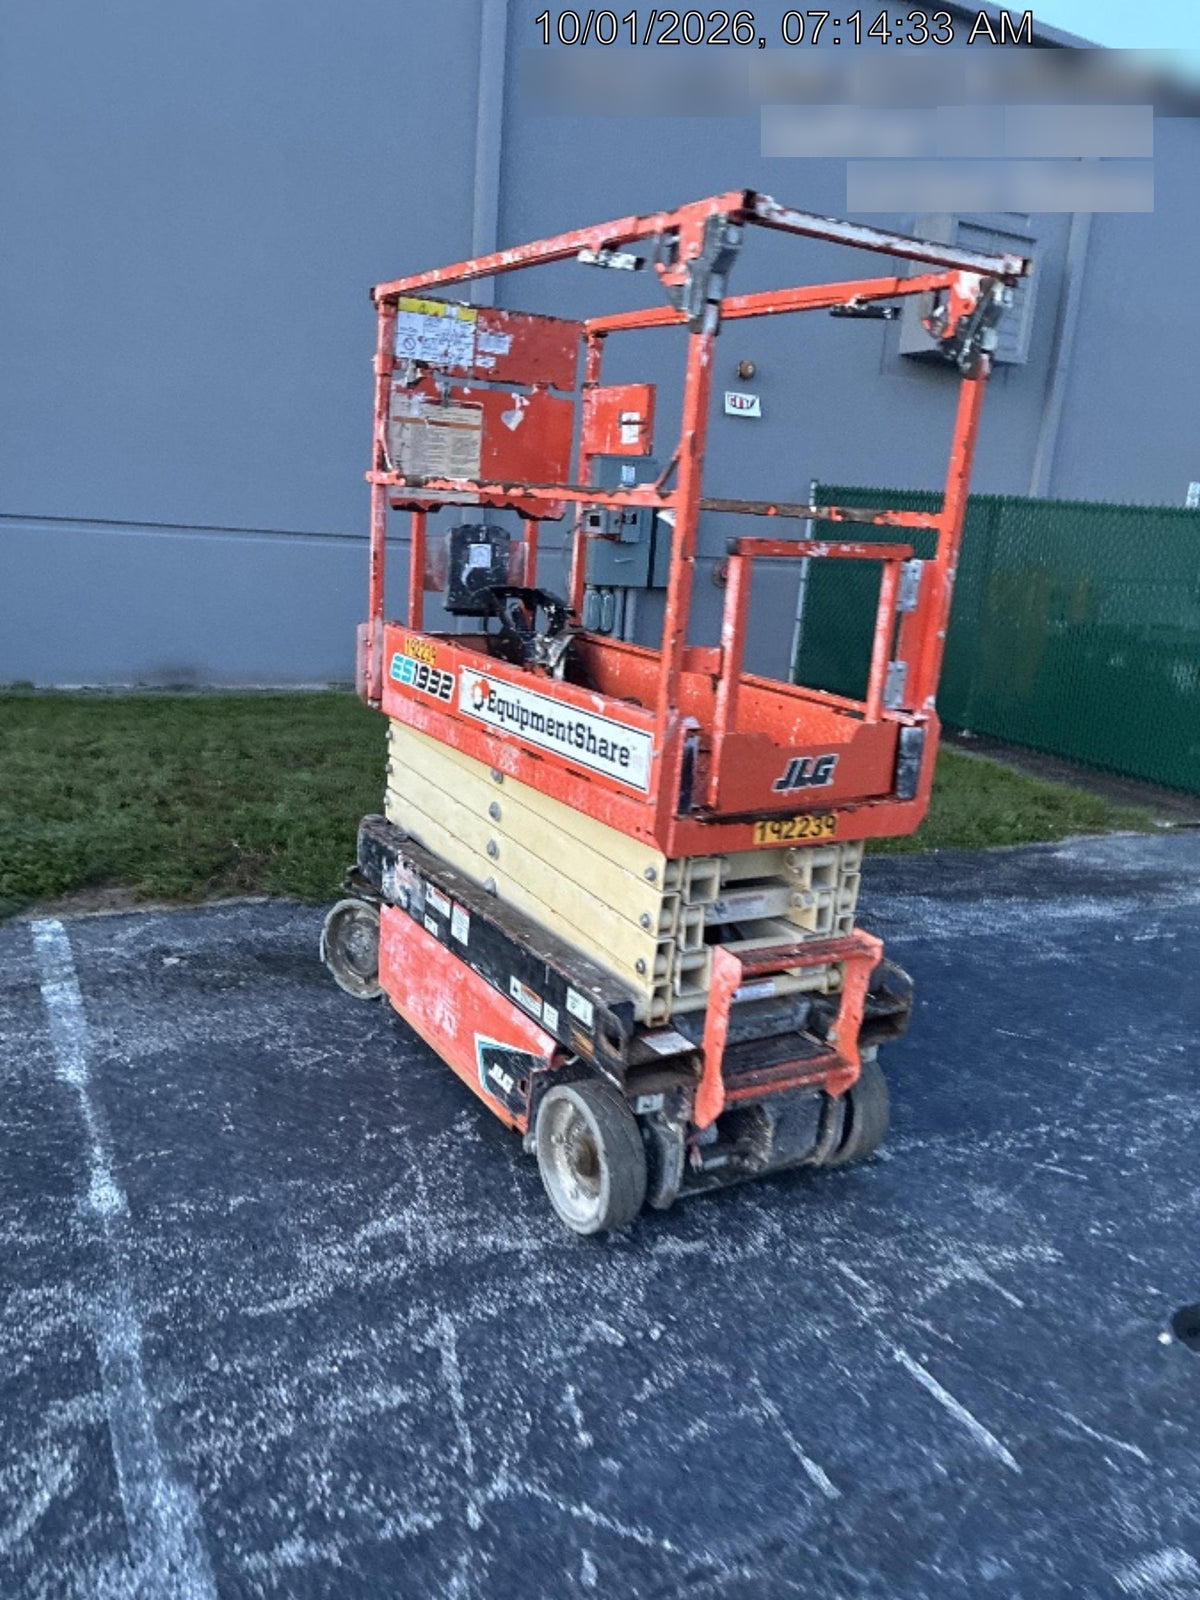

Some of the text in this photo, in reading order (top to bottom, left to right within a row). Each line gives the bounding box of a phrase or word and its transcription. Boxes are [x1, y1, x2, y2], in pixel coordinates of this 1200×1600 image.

[391, 654, 454, 700] ES1932
[486, 689, 631, 768] EquipmentShare
[772, 754, 839, 792] JLG
[756, 815, 837, 842] 192239
